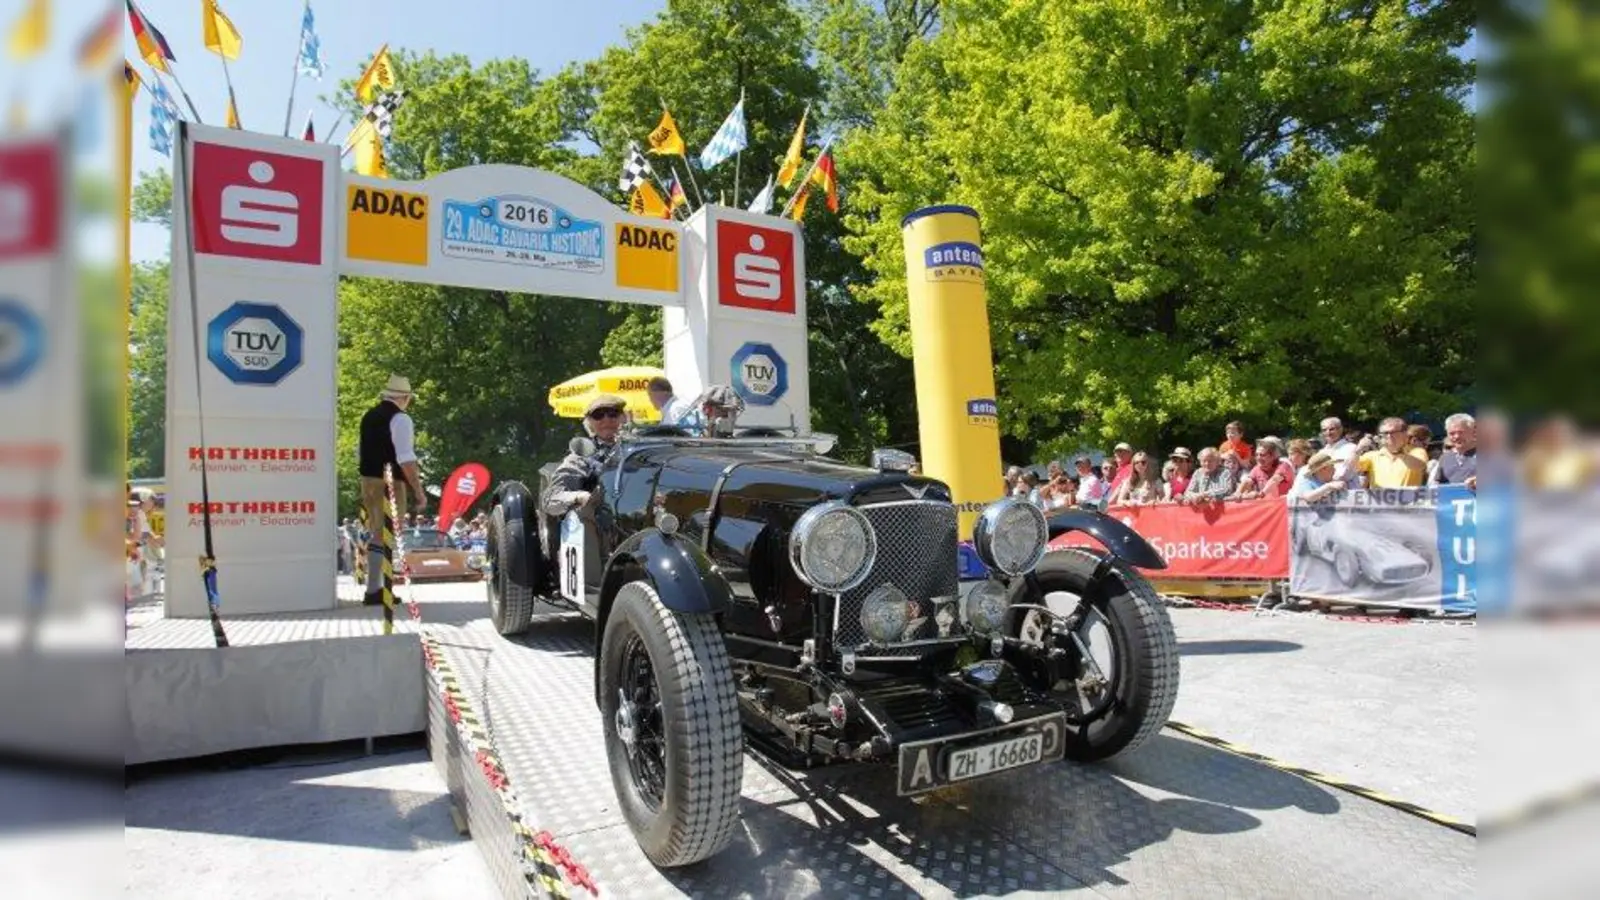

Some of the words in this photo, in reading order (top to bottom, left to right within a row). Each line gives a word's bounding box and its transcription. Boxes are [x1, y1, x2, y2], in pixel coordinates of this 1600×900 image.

[351, 188, 425, 220] ADAC
[504, 203, 549, 225] 2016
[446, 206, 466, 241] 29.
[467, 216, 499, 246] ADAC
[501, 227, 549, 252] BAVARIA
[550, 226, 601, 258] HISTORIC
[618, 226, 675, 252] ADAC
[231, 331, 281, 352] TÜV
[243, 355, 270, 367] SÜD
[618, 379, 651, 391] ADAC
[188, 447, 317, 461] KATHREIN
[261, 463, 317, 473] Electronic
[187, 501, 316, 514] KATHREIN
[259, 516, 316, 527] Electronic
[1150, 535, 1269, 564] Sparkasse
[565, 546, 577, 598] 18
